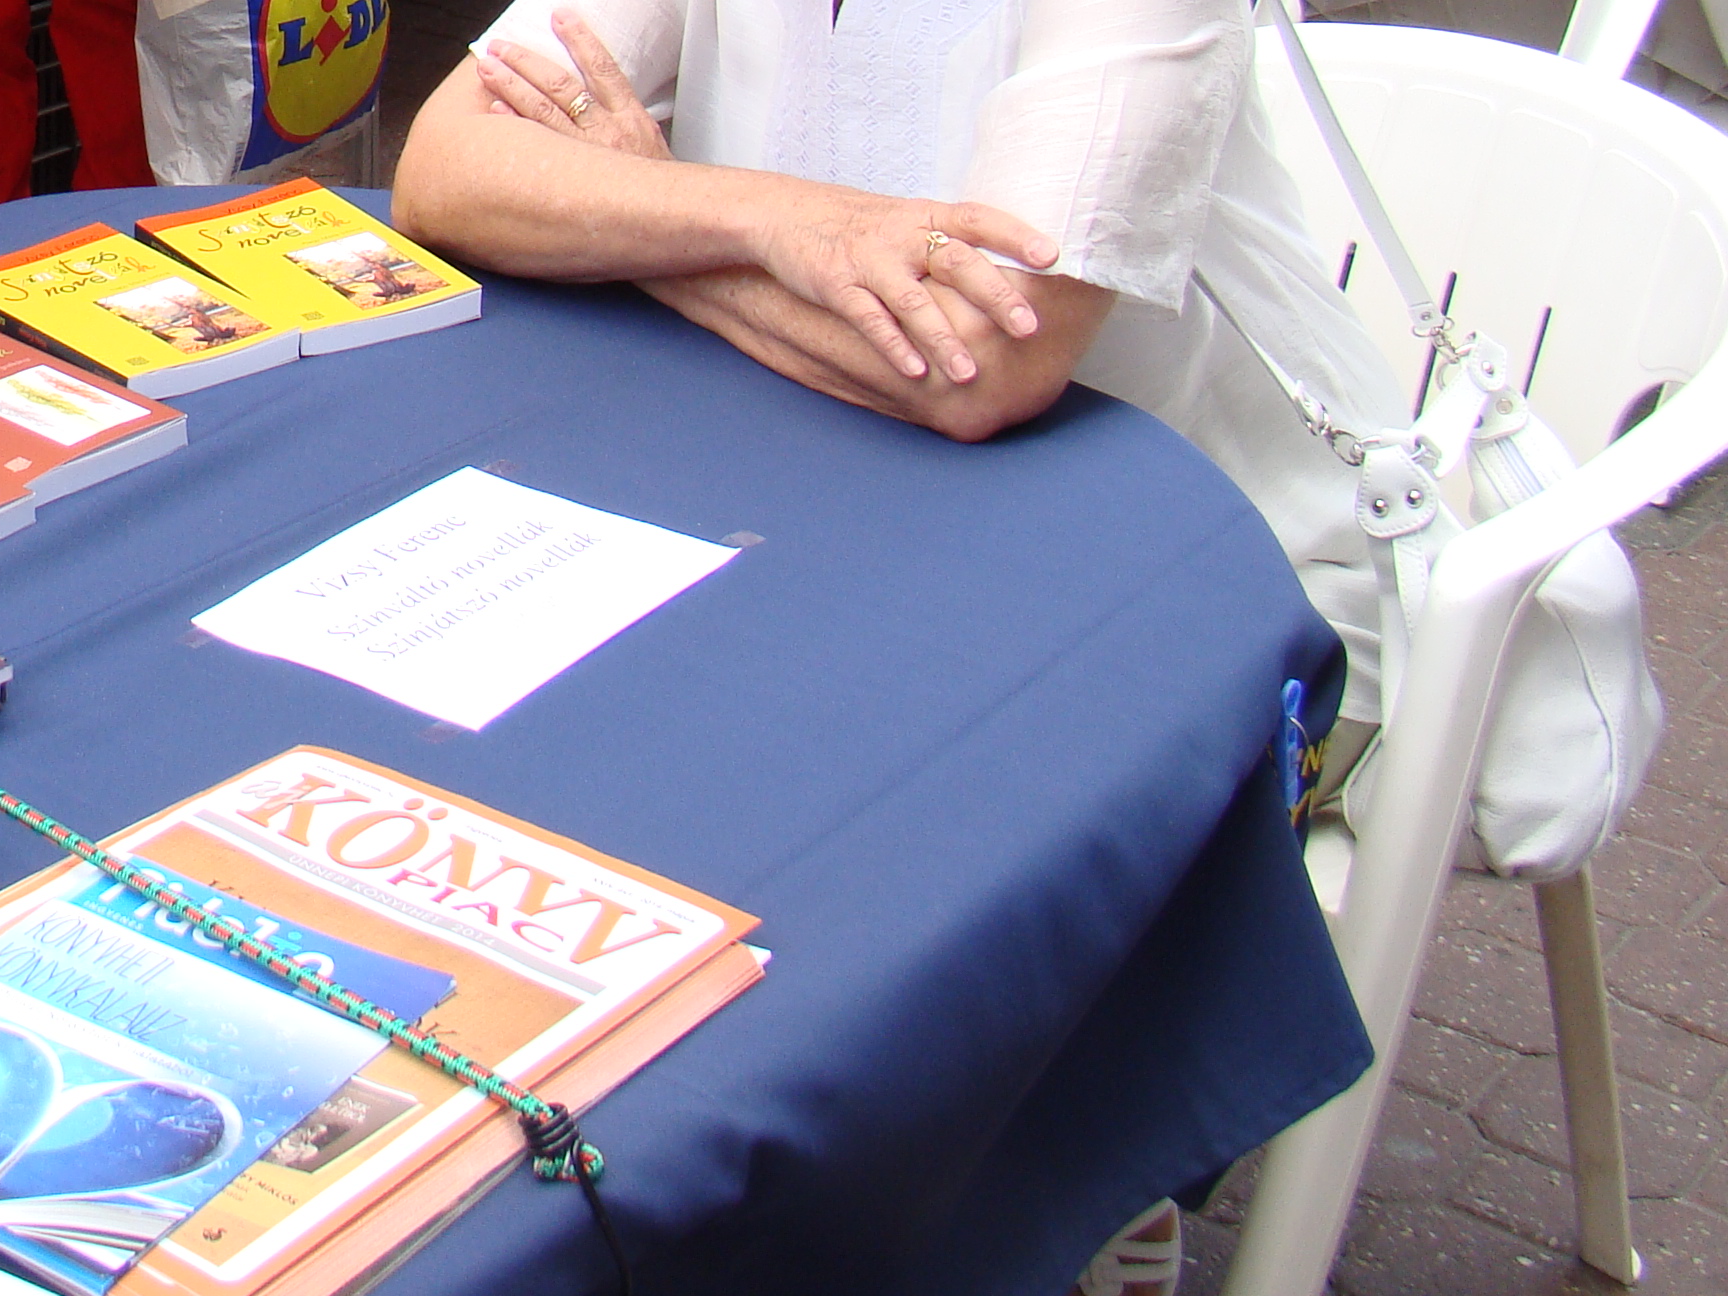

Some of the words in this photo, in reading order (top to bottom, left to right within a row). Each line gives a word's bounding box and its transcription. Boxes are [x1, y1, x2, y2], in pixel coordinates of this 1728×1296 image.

[238, 211, 352, 250] novellák
[44, 256, 158, 298] novellák
[374, 516, 467, 562] Ferenc
[451, 520, 554, 580] novellák
[500, 532, 602, 591] novellák
[289, 853, 352, 893] ÜNNEPI
[451, 922, 497, 949] 2014
[385, 869, 565, 952] PIAC
